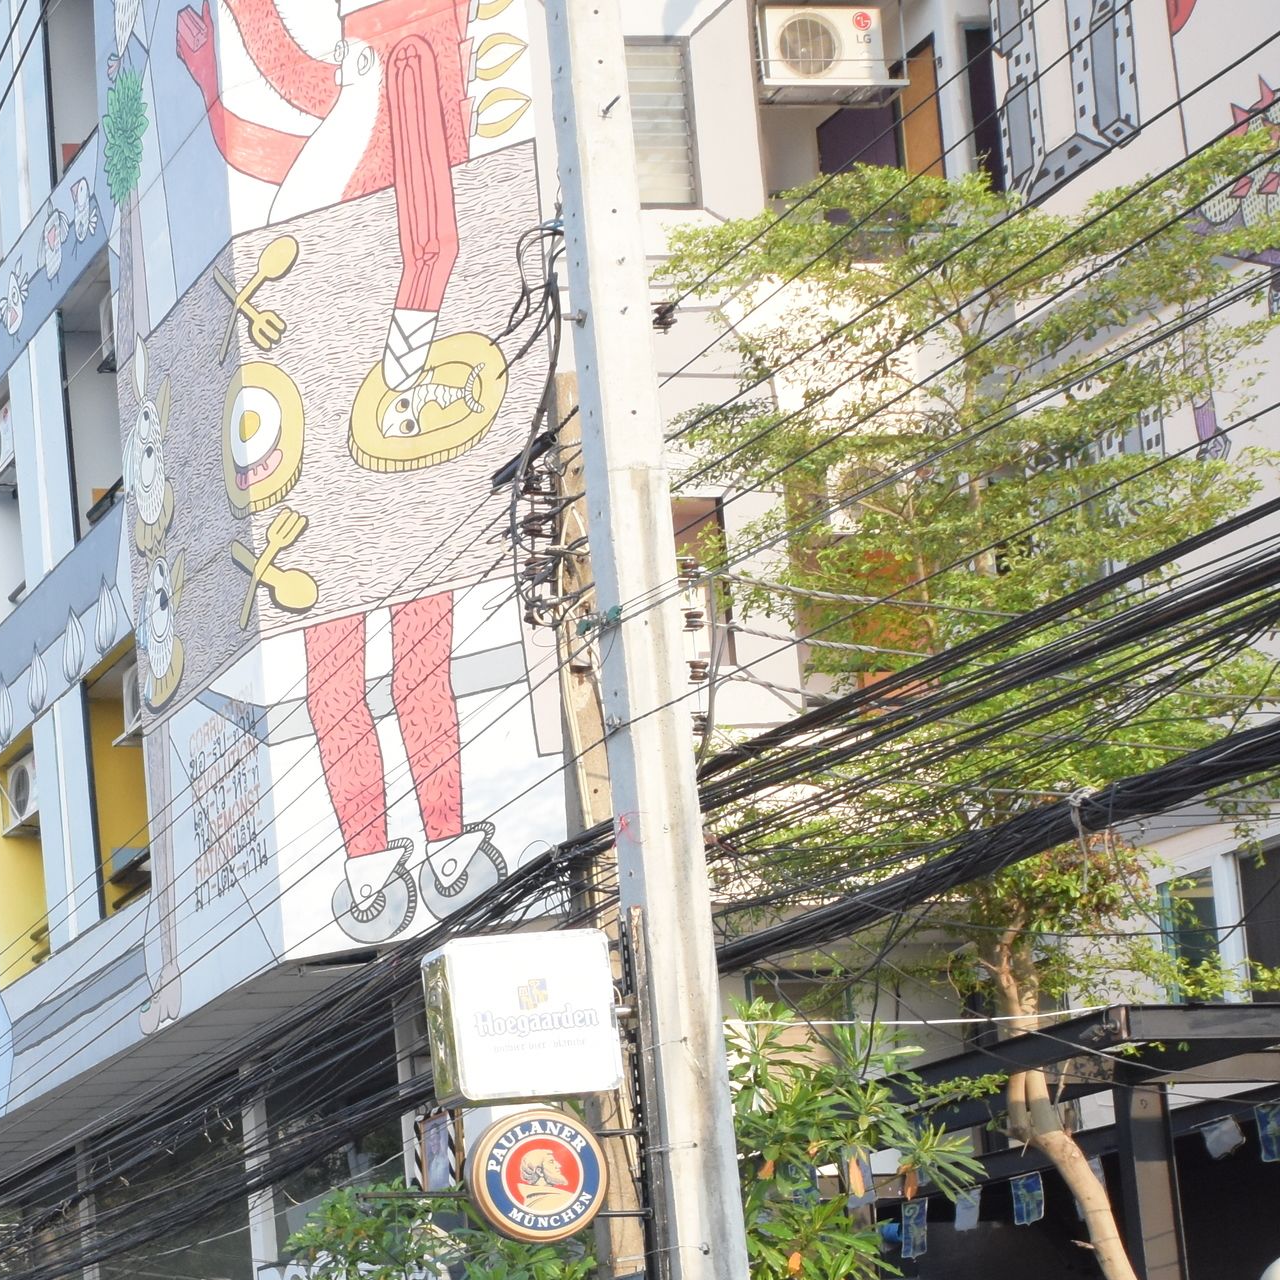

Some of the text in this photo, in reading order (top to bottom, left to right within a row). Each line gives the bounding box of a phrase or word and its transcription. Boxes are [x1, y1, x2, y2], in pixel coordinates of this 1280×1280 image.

[856, 34, 871, 43] LG
[473, 1003, 599, 1038] Hoegaarden
[487, 1120, 587, 1173] PAULANER
[508, 1191, 593, 1229] MÜNCHEN
